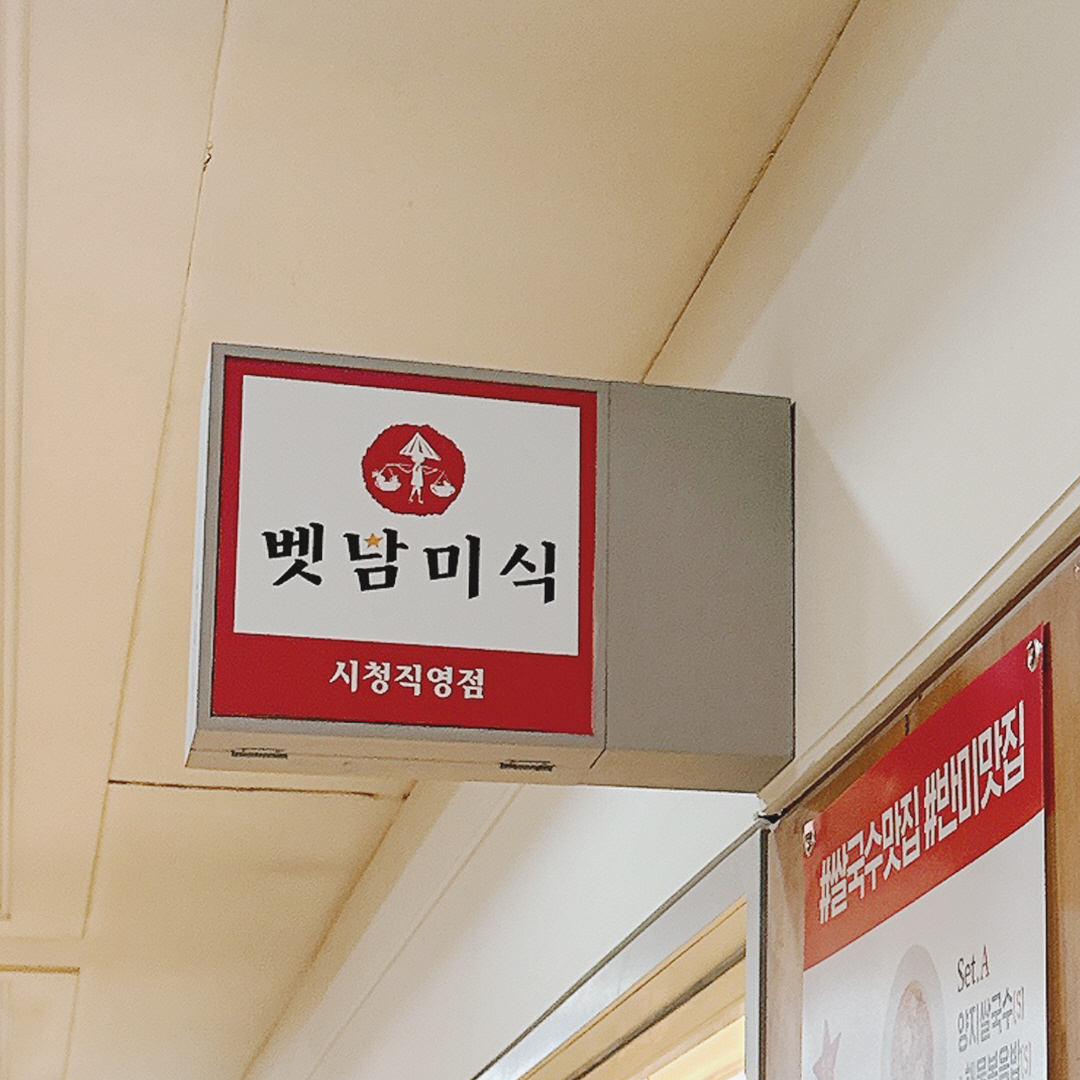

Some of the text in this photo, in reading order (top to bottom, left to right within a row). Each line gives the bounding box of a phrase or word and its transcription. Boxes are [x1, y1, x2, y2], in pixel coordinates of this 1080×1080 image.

[261, 522, 558, 604] 벳남미식
[329, 660, 485, 700] 시청직영점
[819, 700, 1025, 925] #쌀국수맛집 #반미맛집
[957, 944, 990, 993] Set.A
